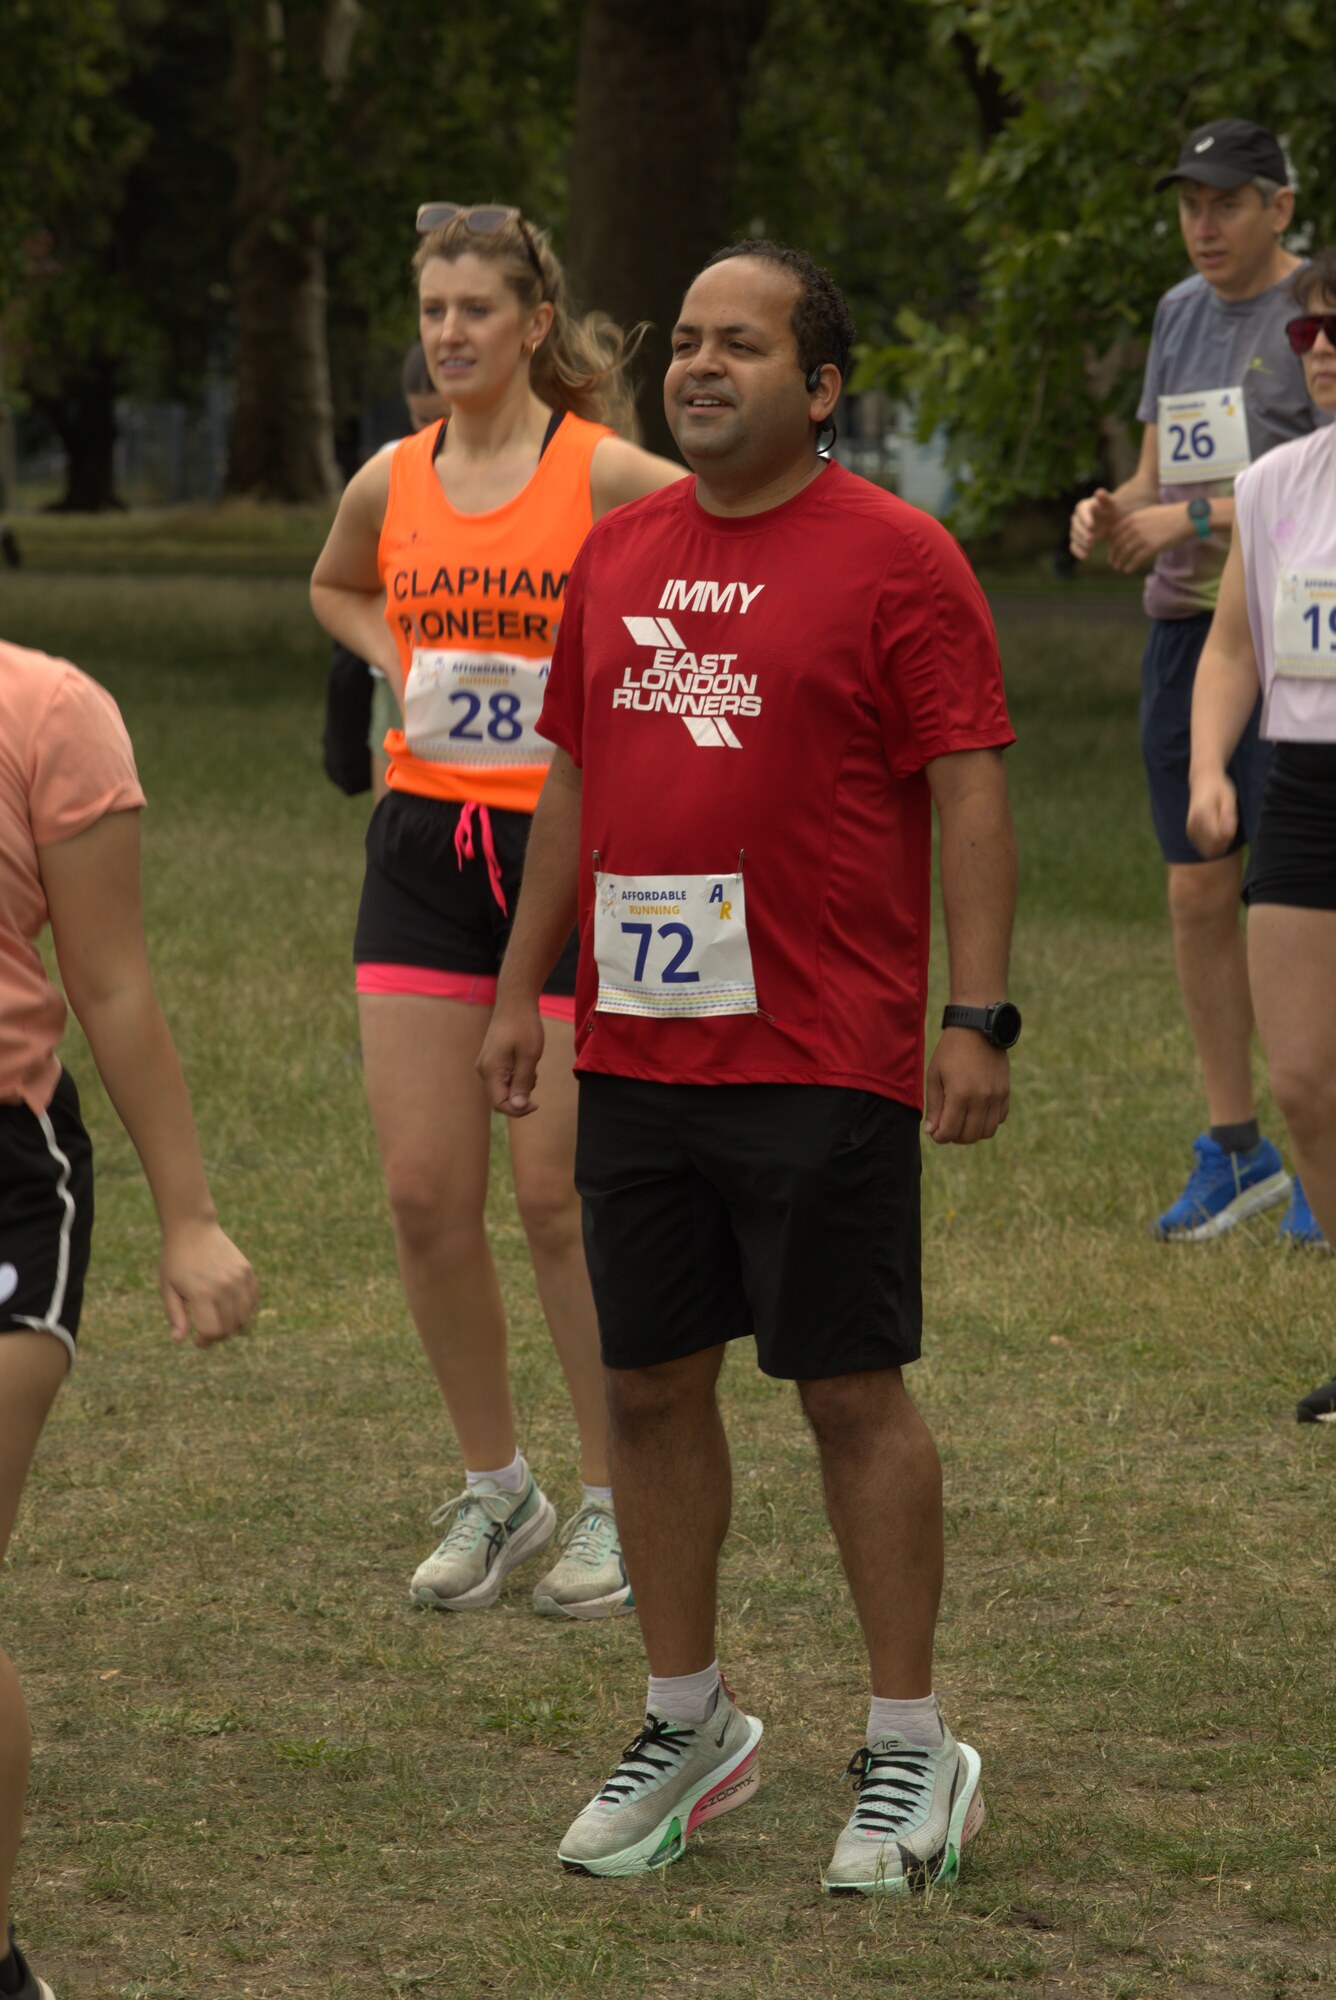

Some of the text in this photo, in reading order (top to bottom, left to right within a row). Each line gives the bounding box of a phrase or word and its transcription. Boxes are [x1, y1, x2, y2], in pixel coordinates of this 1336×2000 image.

[1168, 420, 1215, 461] 26
[394, 566, 569, 602] CLAPHAM
[658, 579, 766, 614] IMMY
[653, 649, 738, 675] EAST
[622, 667, 758, 695] LONDON
[448, 690, 523, 743] 28
[612, 688, 763, 717] RUNNERS
[621, 891, 687, 901] AFFORDABLE
[629, 905, 680, 915] RUNNING
[621, 922, 700, 983] 72
